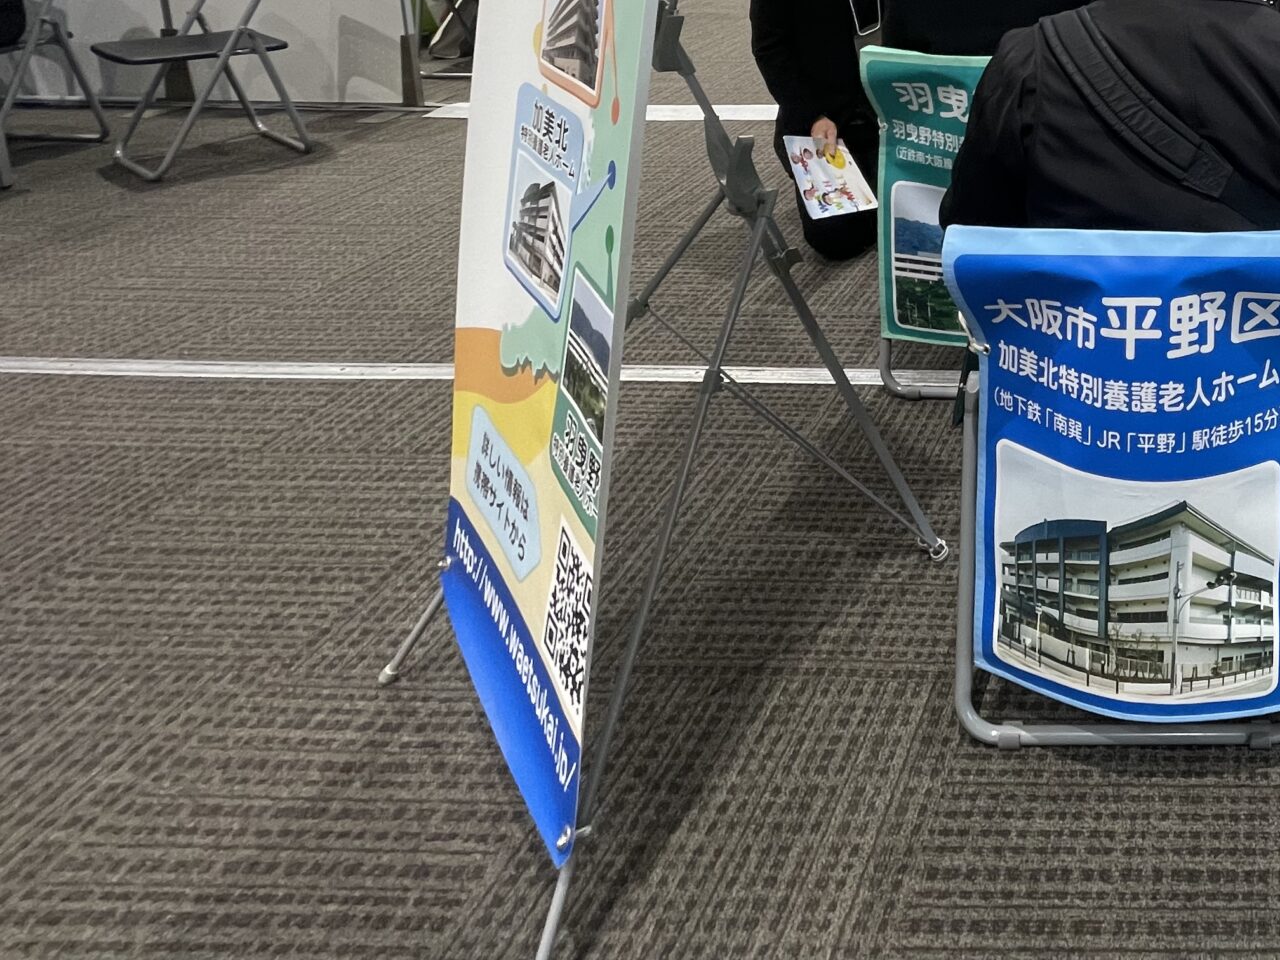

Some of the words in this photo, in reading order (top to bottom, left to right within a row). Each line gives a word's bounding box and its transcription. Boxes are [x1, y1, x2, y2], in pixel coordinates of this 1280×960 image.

[532, 100, 569, 152] 加美北
[892, 82, 976, 123] 羽曳
[998, 340, 1280, 413] 加美北特別養護老人ホーム
[481, 432, 530, 522] 詳しい情報は
[453, 518, 577, 792] http://www.waetsukai.jp/
